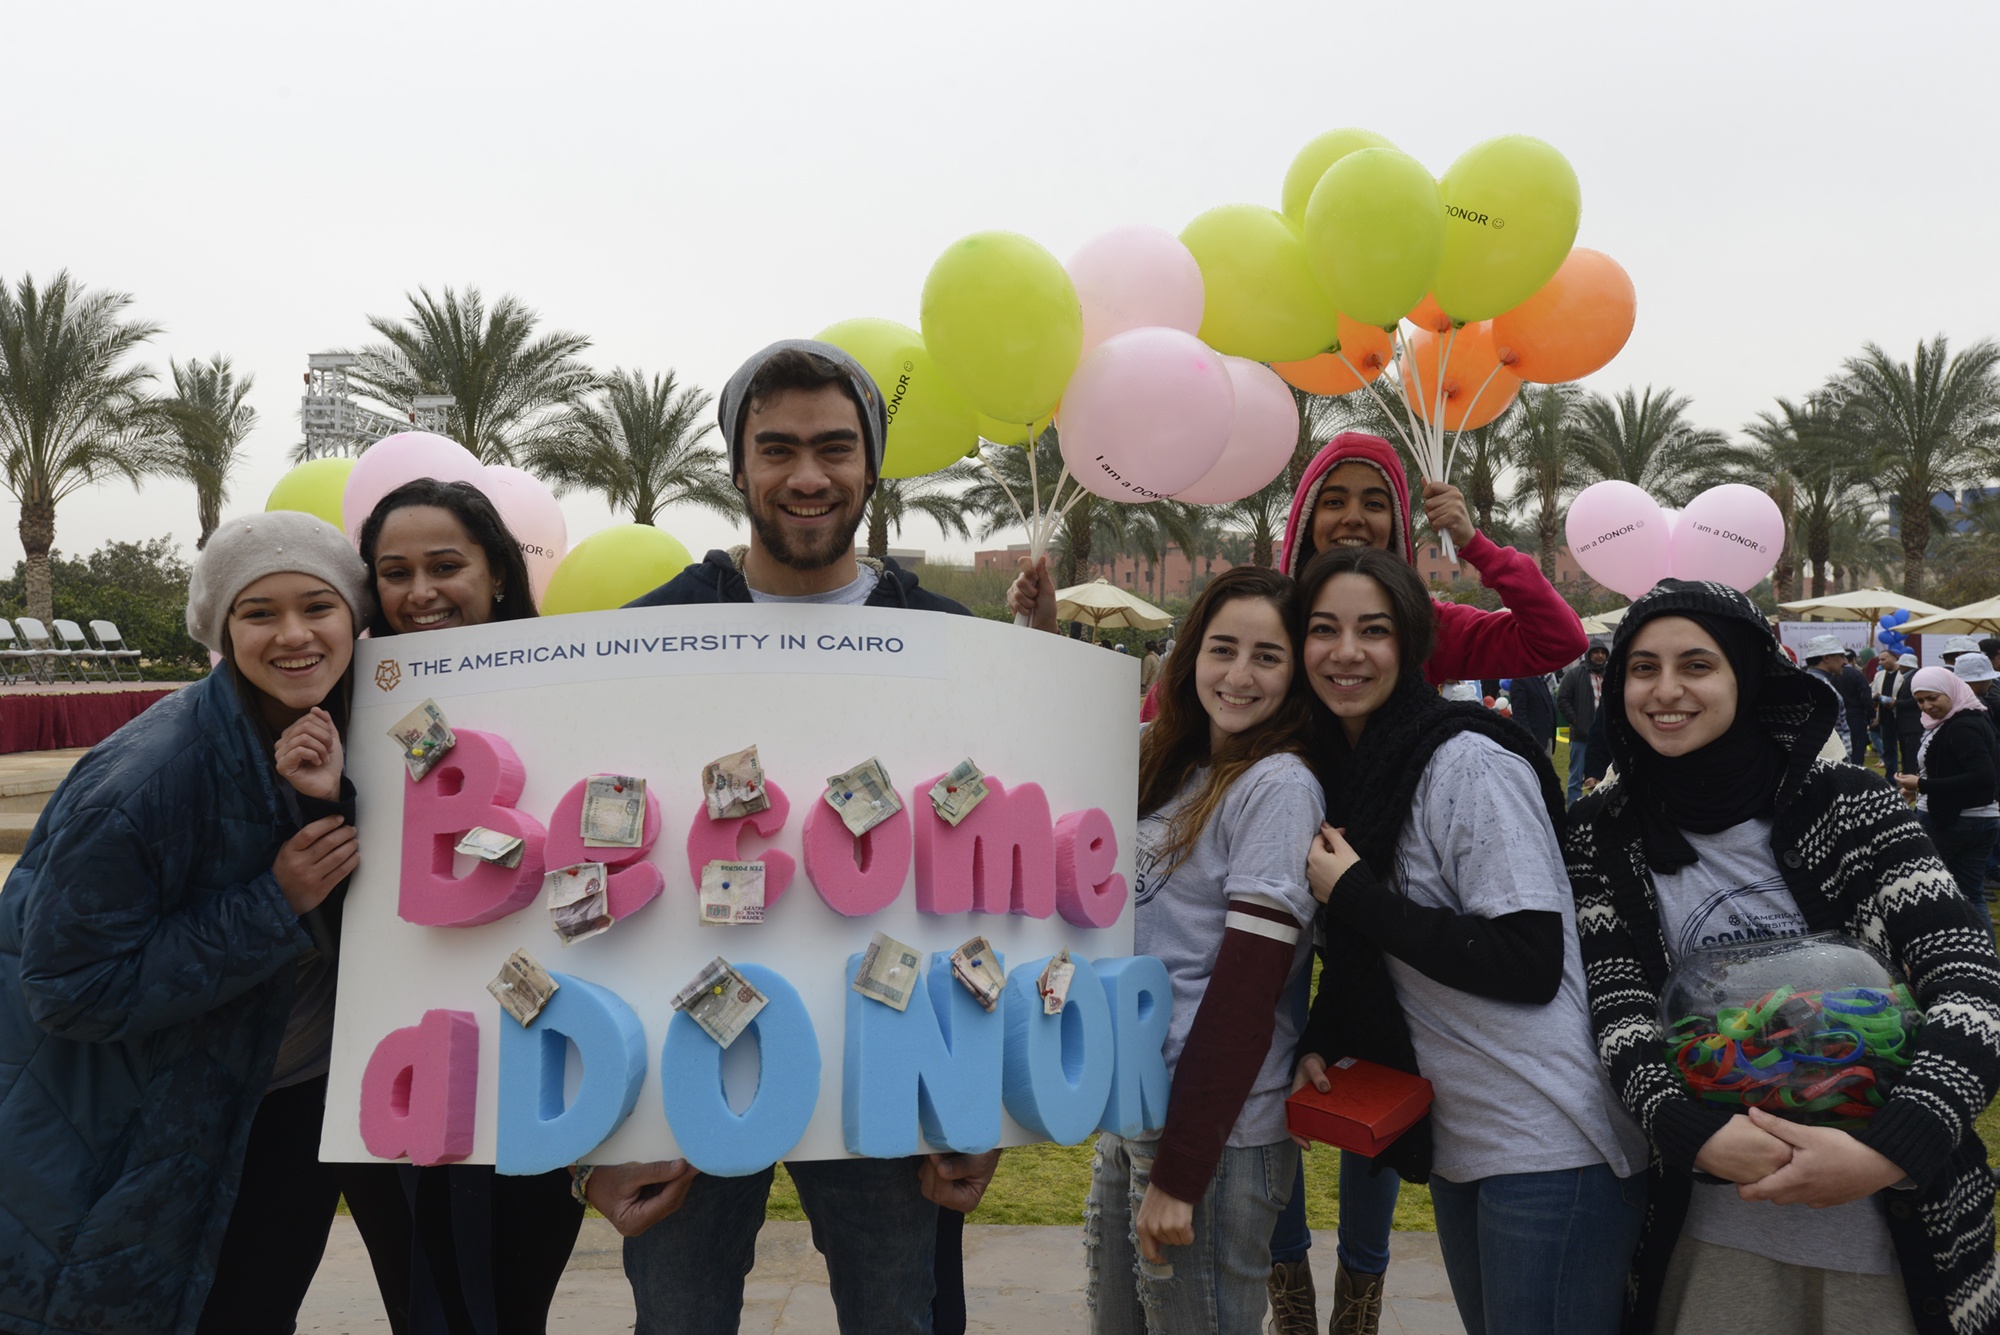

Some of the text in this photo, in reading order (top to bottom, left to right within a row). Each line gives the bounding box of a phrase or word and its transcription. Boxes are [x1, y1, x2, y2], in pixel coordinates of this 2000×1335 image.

[1101, 463, 1121, 481] am
[1579, 544, 1591, 553] am
[1597, 524, 1635, 544] DONOR
[1697, 525, 1712, 534] am
[1721, 530, 1759, 551] DONOR
[408, 634, 904, 677] THE AMERICAN UNIVERSITY IN CAIRO
[494, 949, 1173, 1177] DONOR
